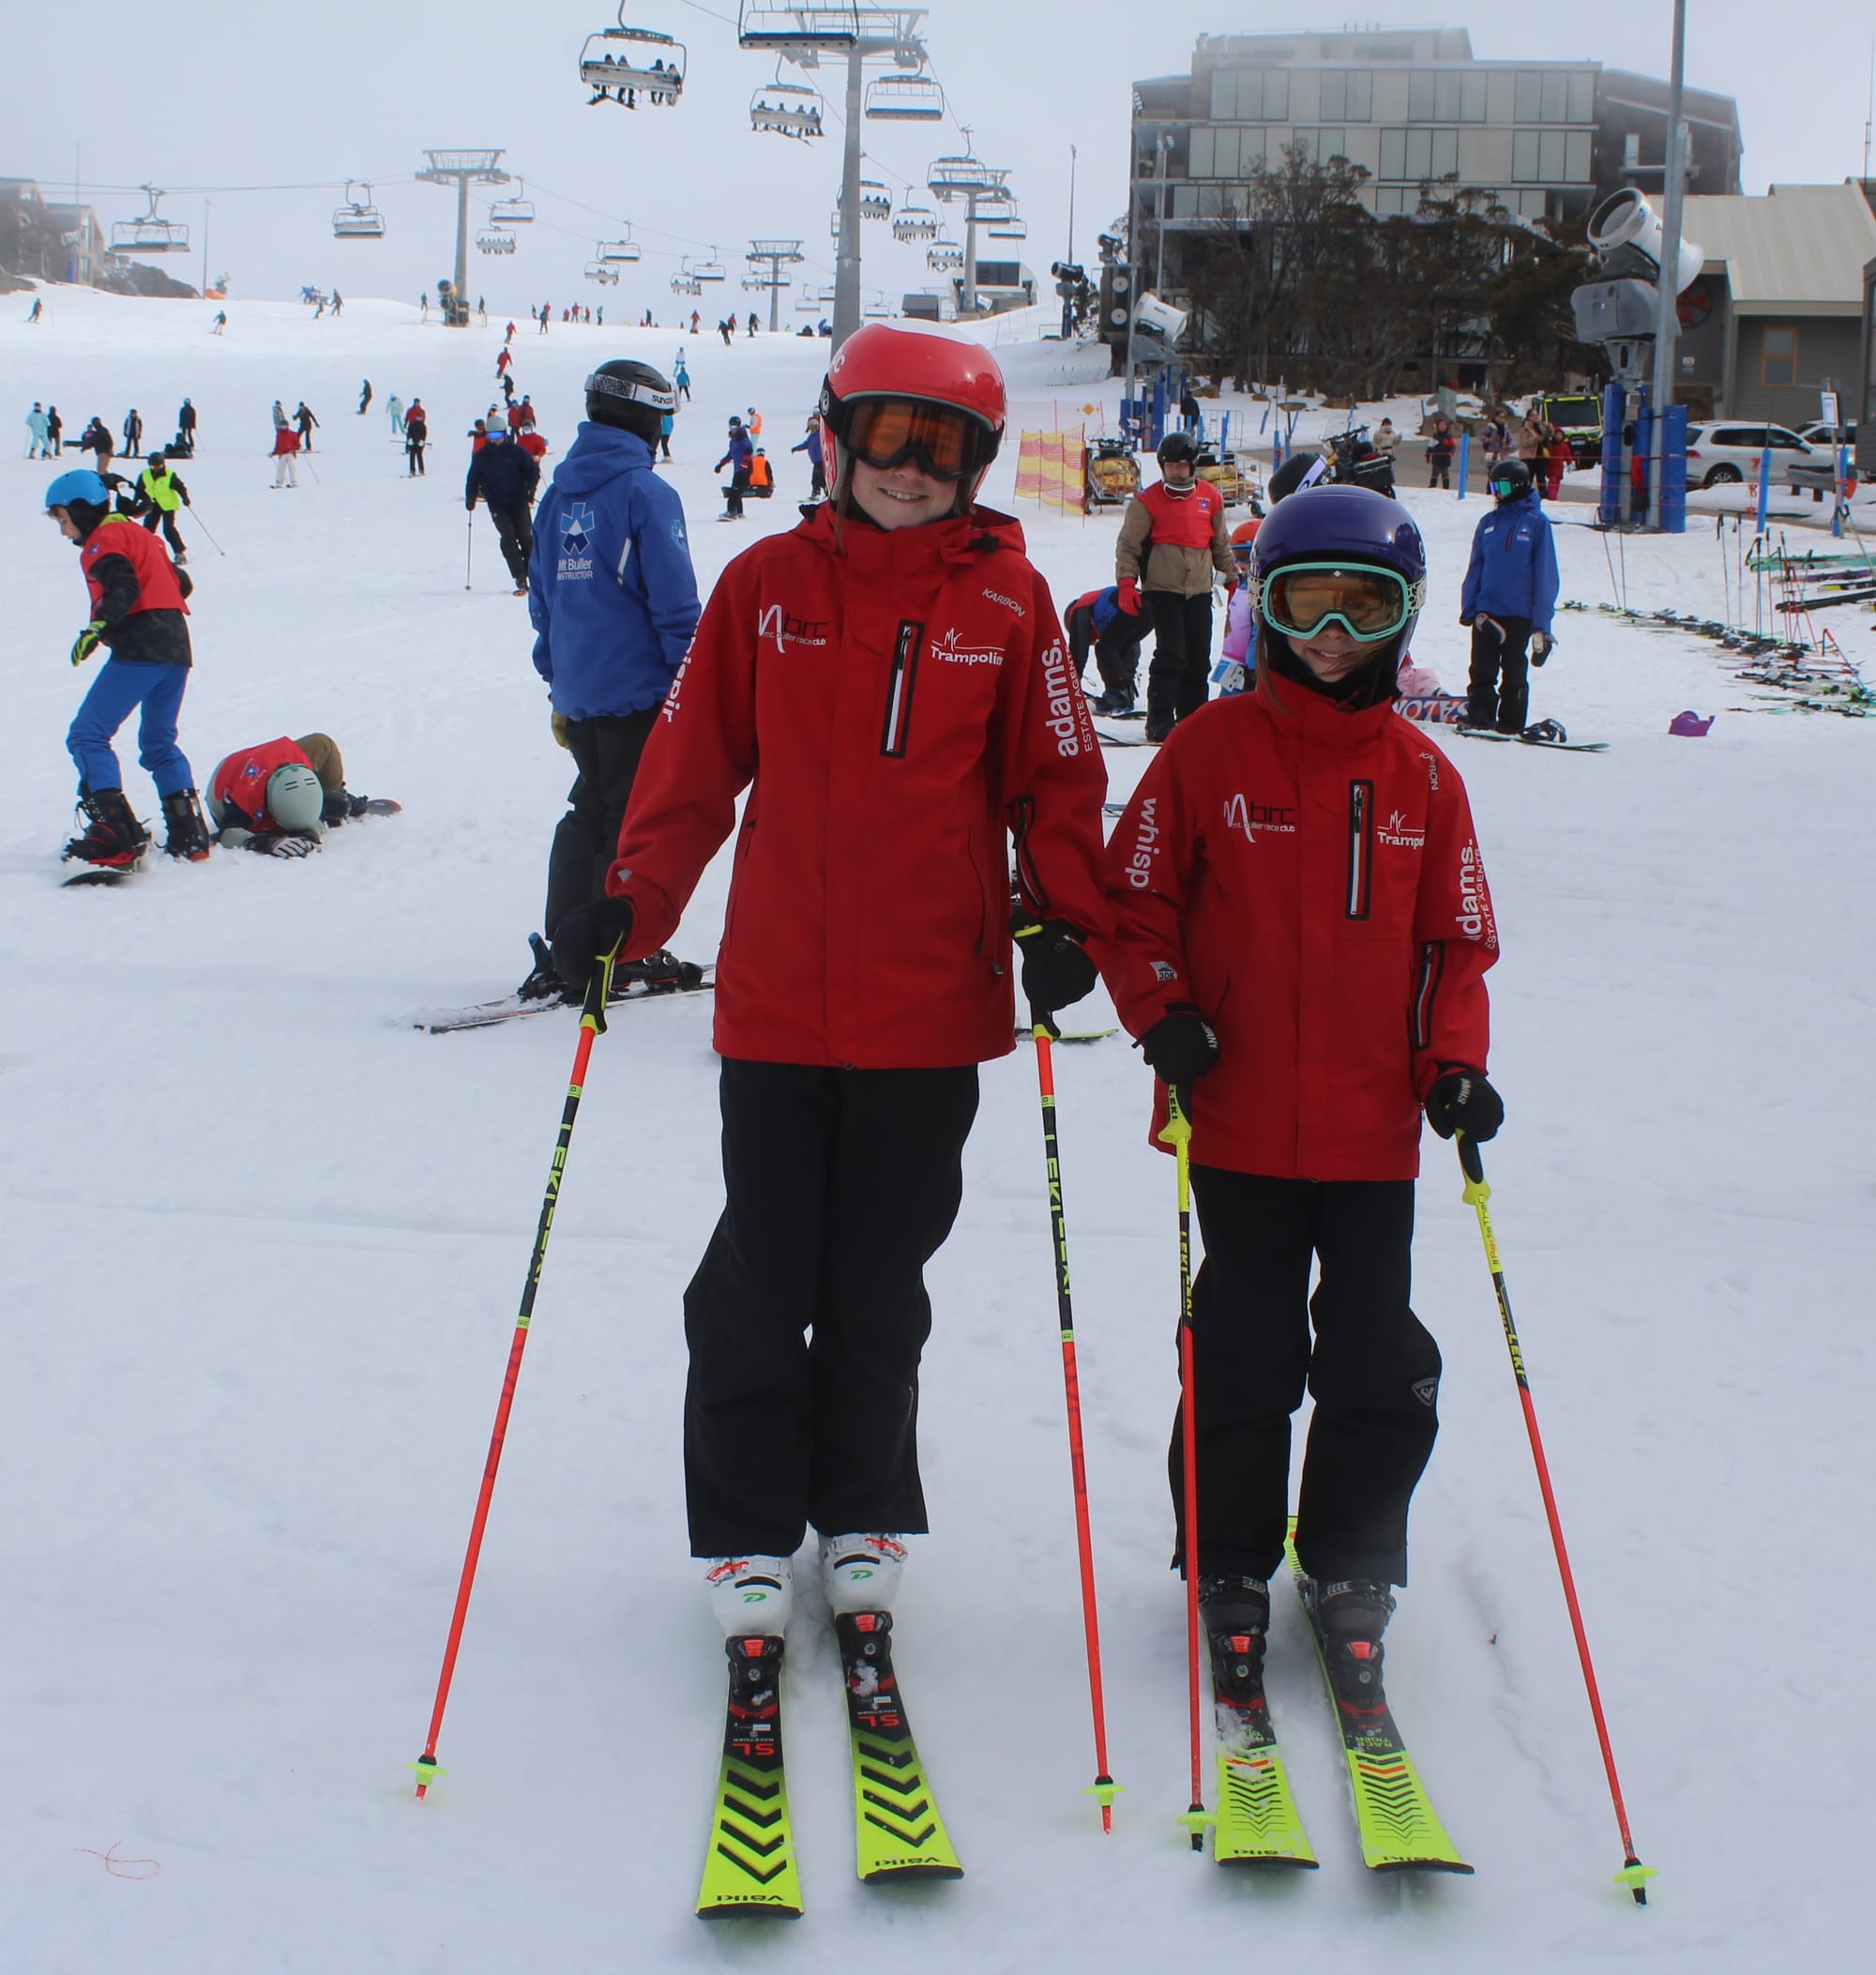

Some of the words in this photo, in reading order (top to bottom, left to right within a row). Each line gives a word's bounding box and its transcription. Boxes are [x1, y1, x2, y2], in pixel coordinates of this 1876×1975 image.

[567, 557, 593, 570] Buller
[982, 588, 1025, 617] KARBON
[812, 637, 826, 646] club
[944, 627, 963, 652] Mr
[1042, 638, 1080, 757] adams.
[1076, 700, 1094, 752] ESTATE
[1280, 825, 1295, 833] club
[1389, 810, 1407, 835] Mr
[1169, 1089, 1179, 1120] LEKI
[1508, 1333, 1526, 1375] LEKI
[857, 1713, 900, 1727] SL
[732, 1742, 776, 1755] SL
